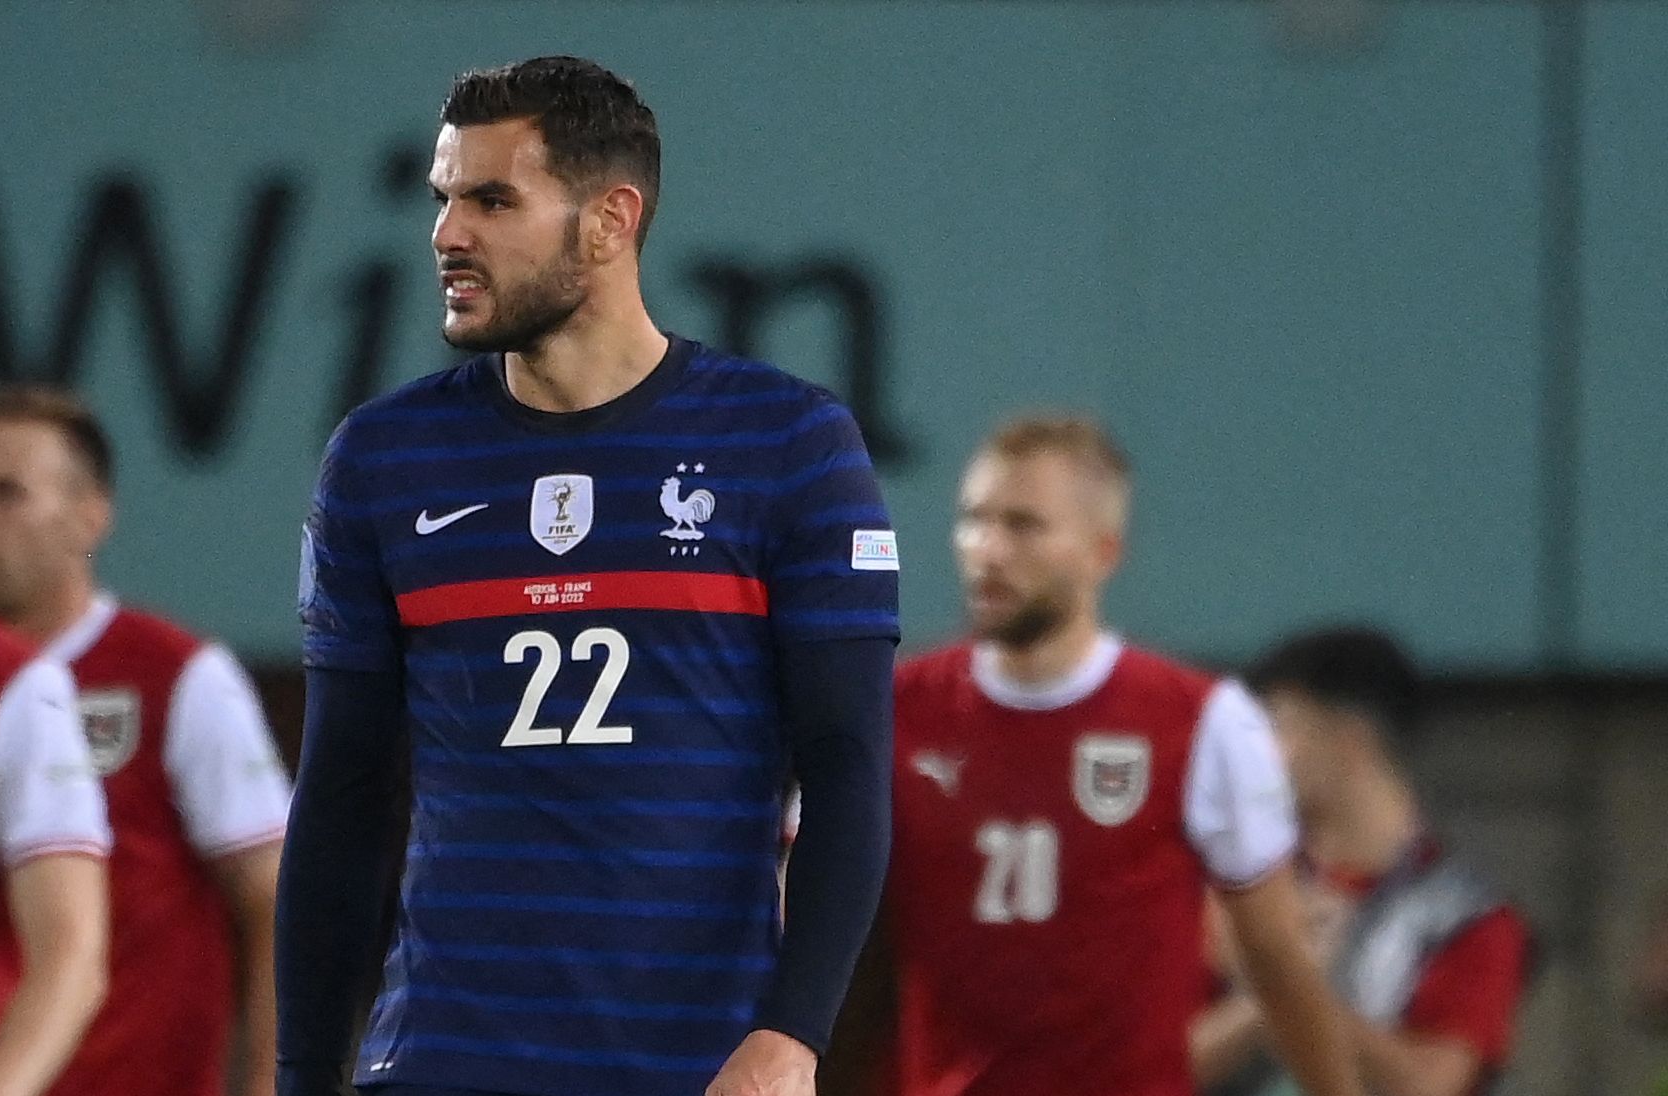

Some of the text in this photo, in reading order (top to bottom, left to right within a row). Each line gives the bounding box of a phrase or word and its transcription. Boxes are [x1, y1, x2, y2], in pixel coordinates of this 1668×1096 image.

[548, 524, 576, 535] FIFA
[500, 628, 633, 747] 22
[975, 821, 1060, 923] 20
